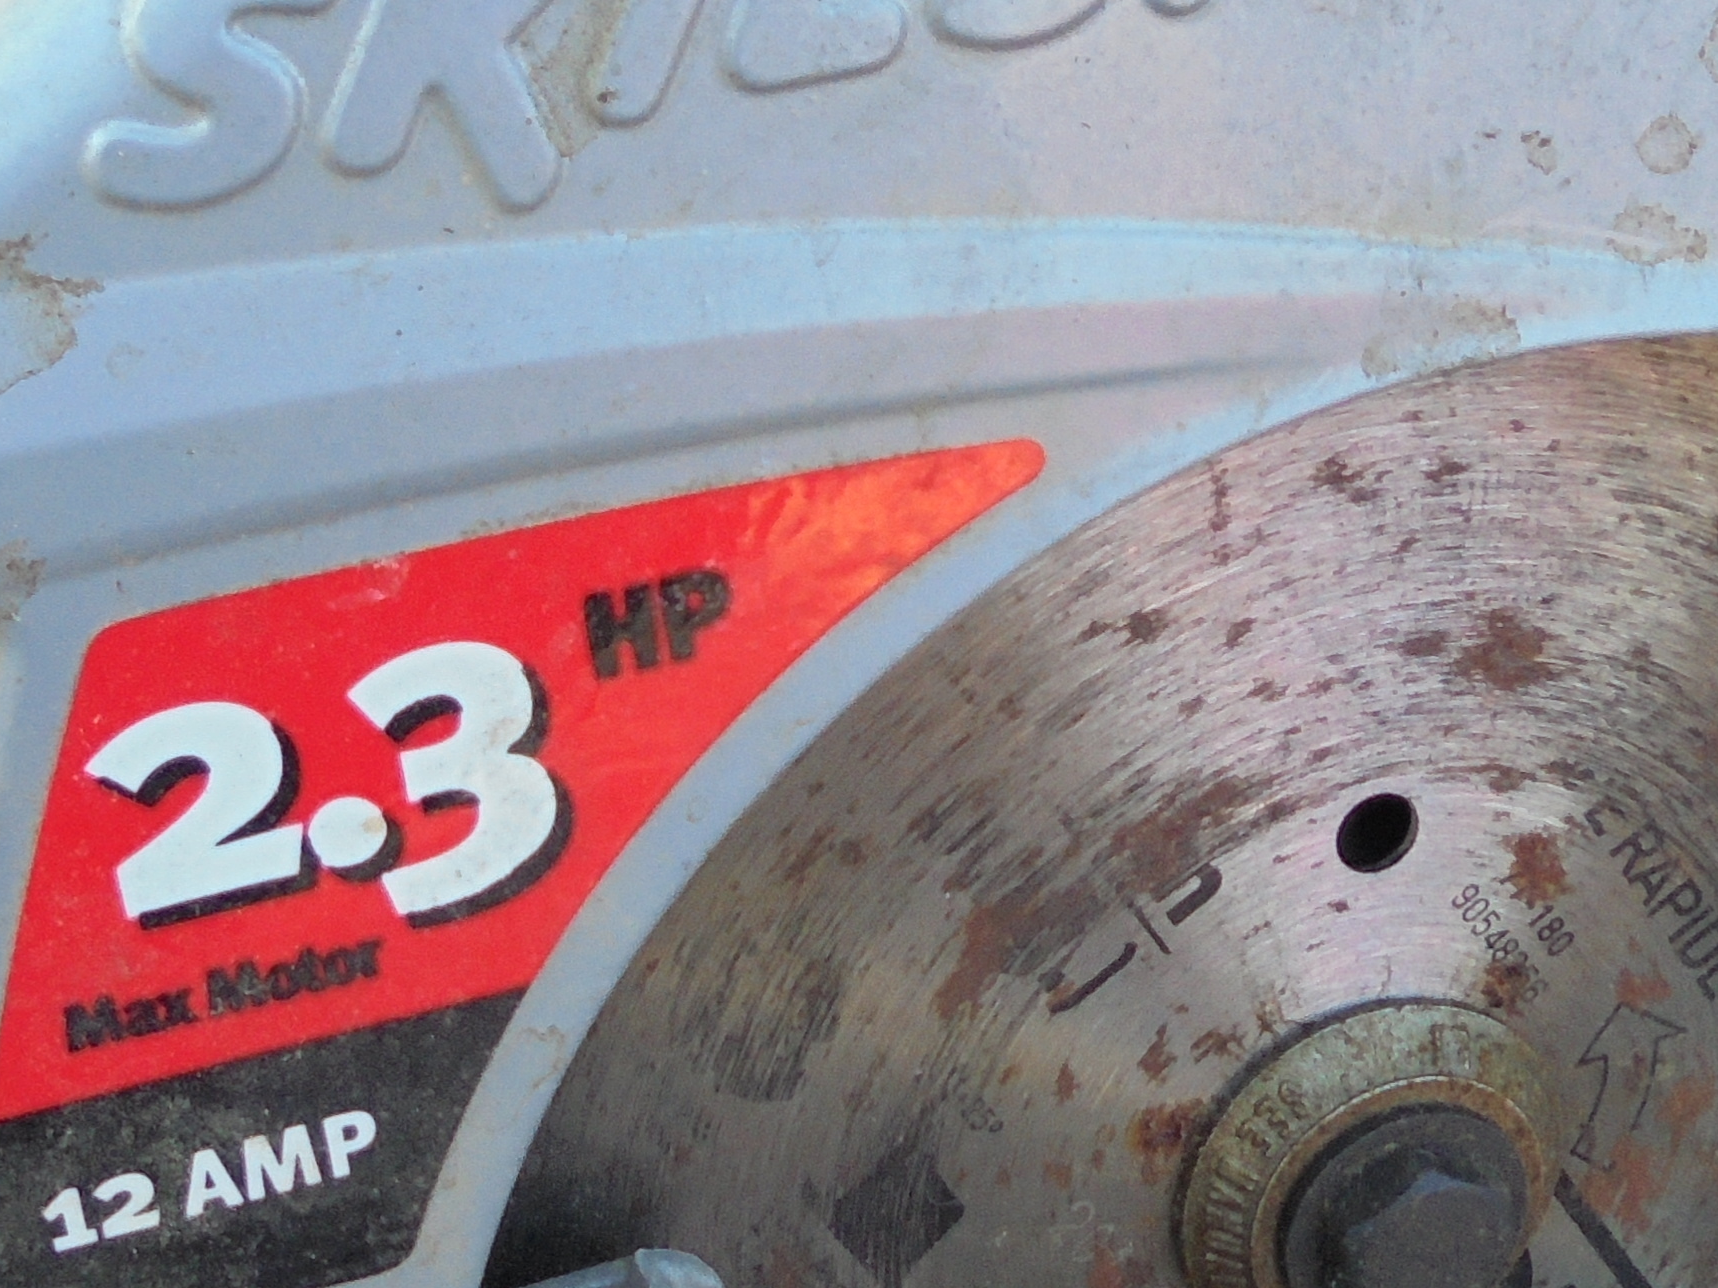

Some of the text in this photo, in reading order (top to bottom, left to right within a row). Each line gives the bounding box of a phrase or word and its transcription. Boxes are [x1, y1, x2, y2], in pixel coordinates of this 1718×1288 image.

[84, 566, 732, 929] 2.3 HP
[63, 938, 382, 1053] Max Motor
[42, 1110, 377, 1253] 12 AMP
